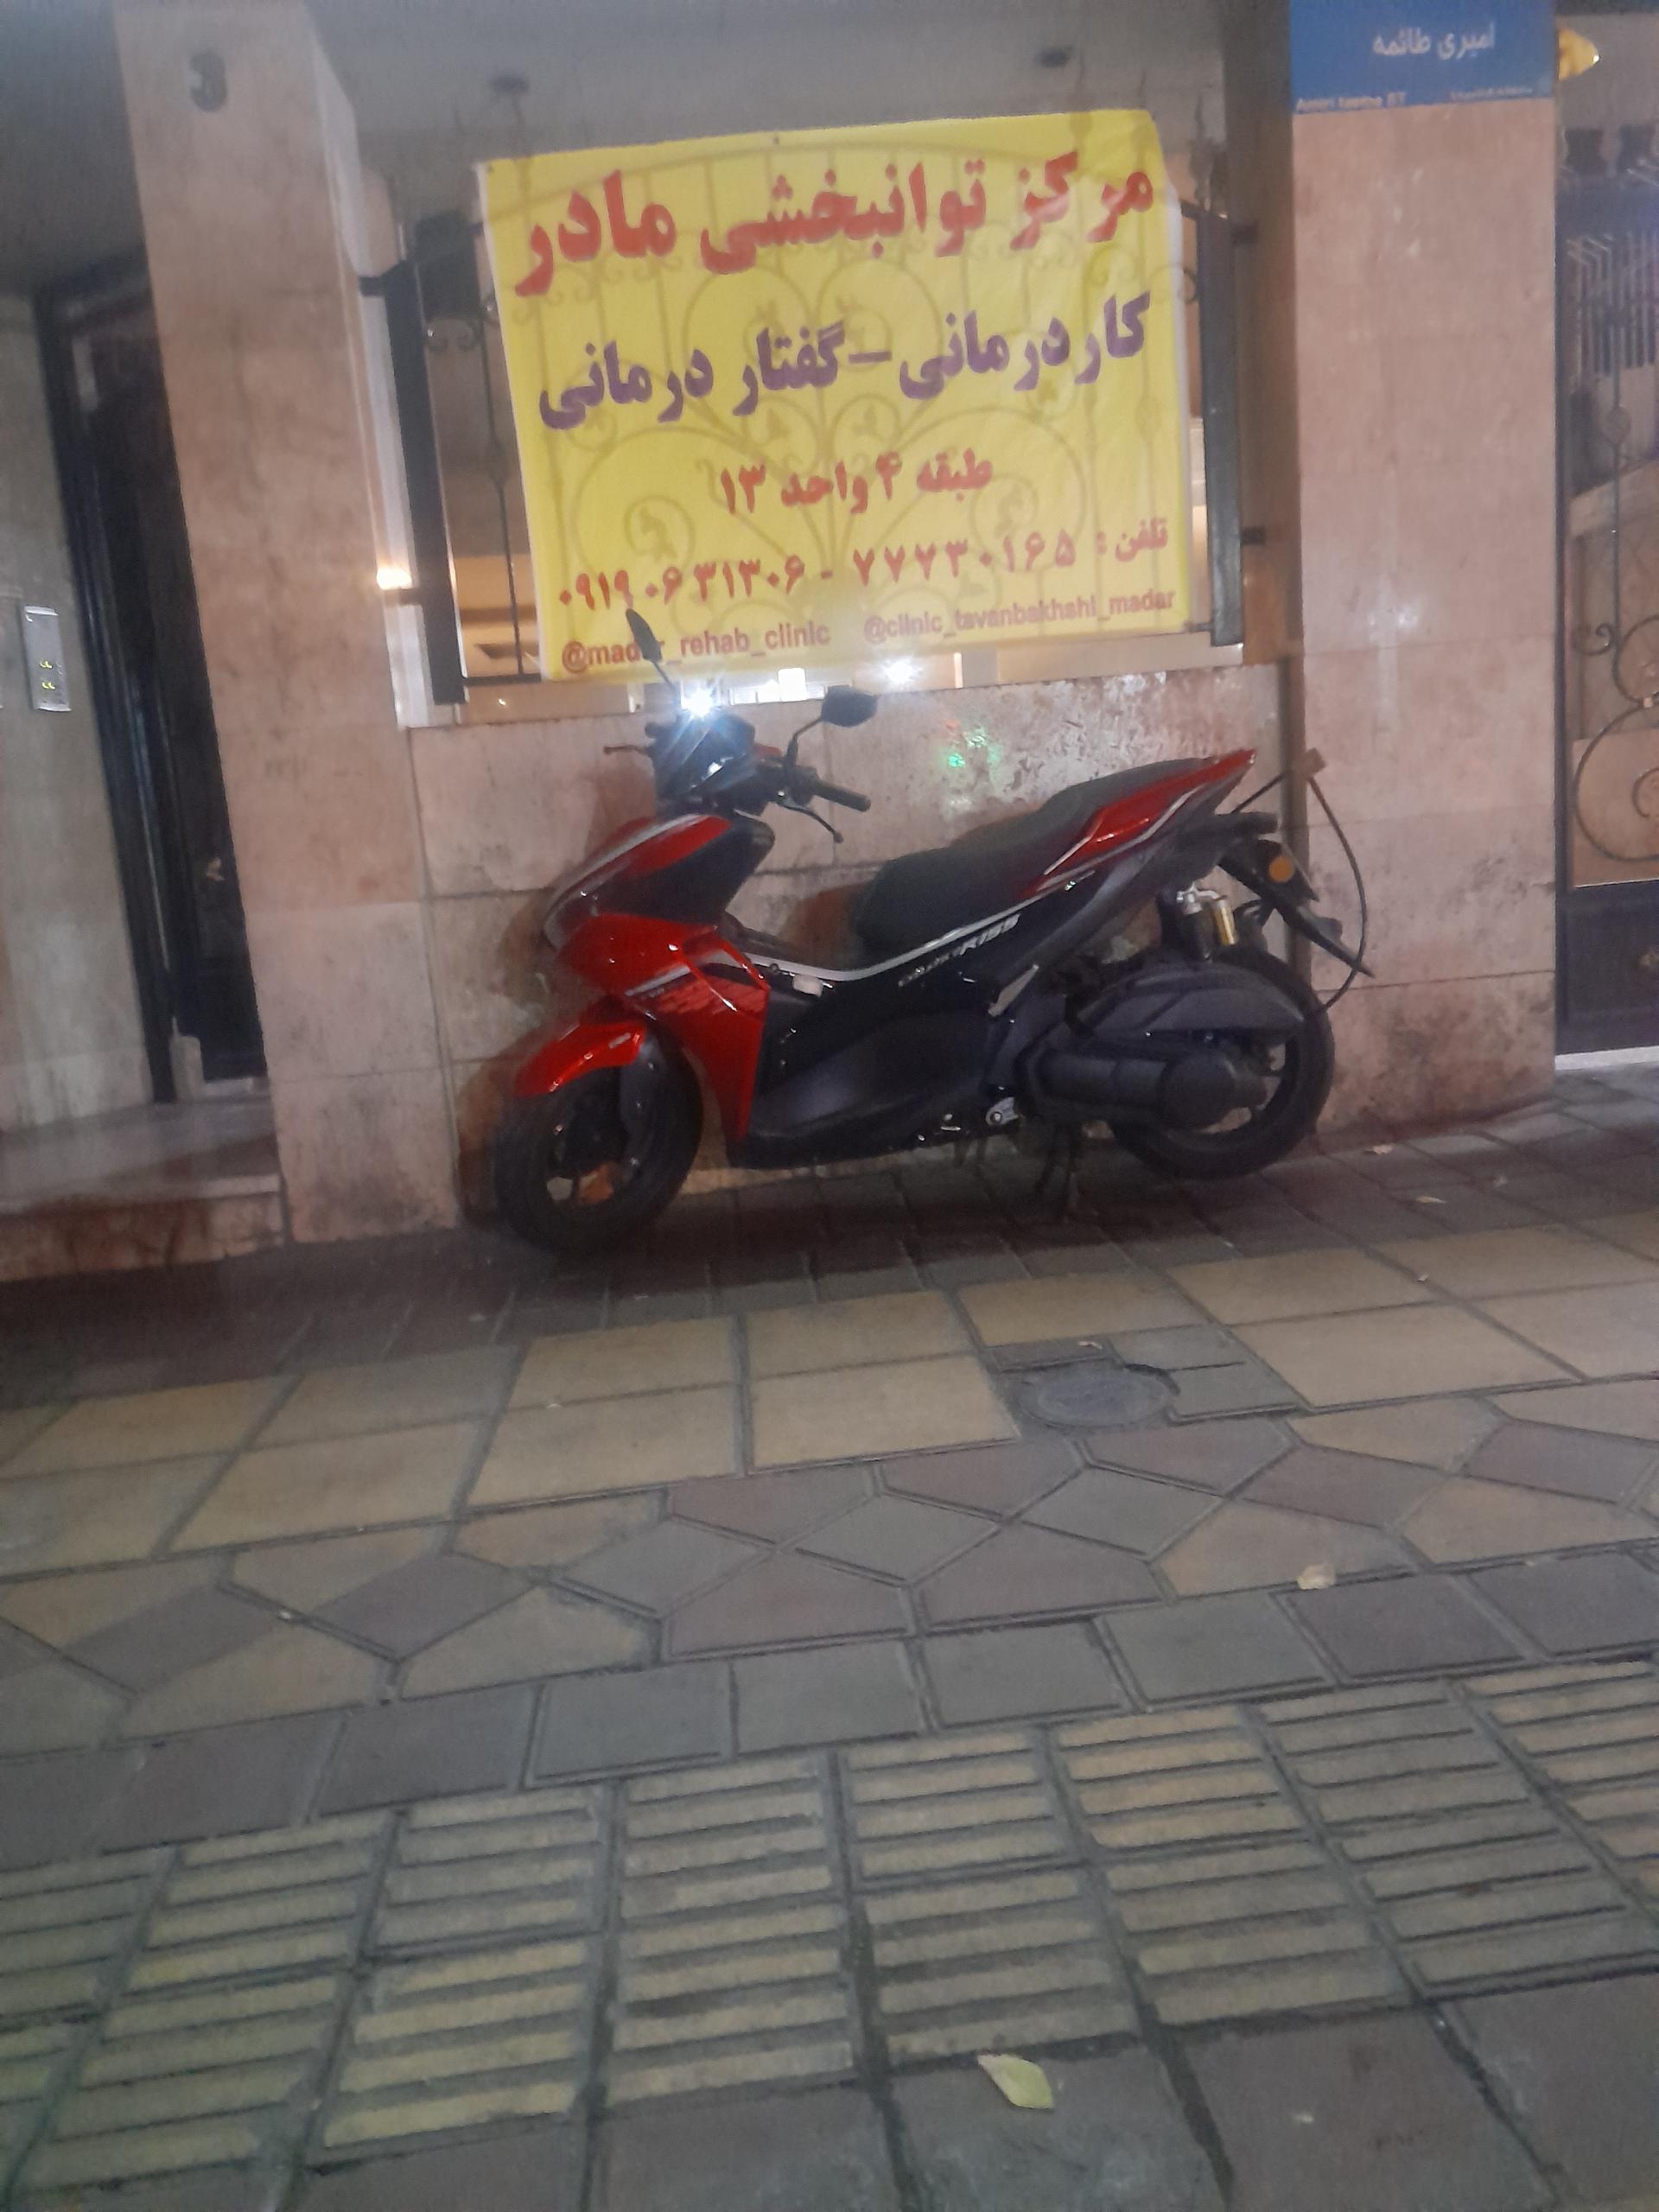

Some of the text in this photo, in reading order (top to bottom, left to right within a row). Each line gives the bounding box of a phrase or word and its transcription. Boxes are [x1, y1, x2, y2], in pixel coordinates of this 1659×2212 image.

[515, 149, 1154, 296] مرکز توانبخشی مادر
[538, 339, 715, 430] درمانی
[733, 321, 846, 416] گفتار
[721, 448, 994, 515] طبقه ۴ واحد ۱۳
[562, 620, 831, 675] @mad_rehab_clinic
